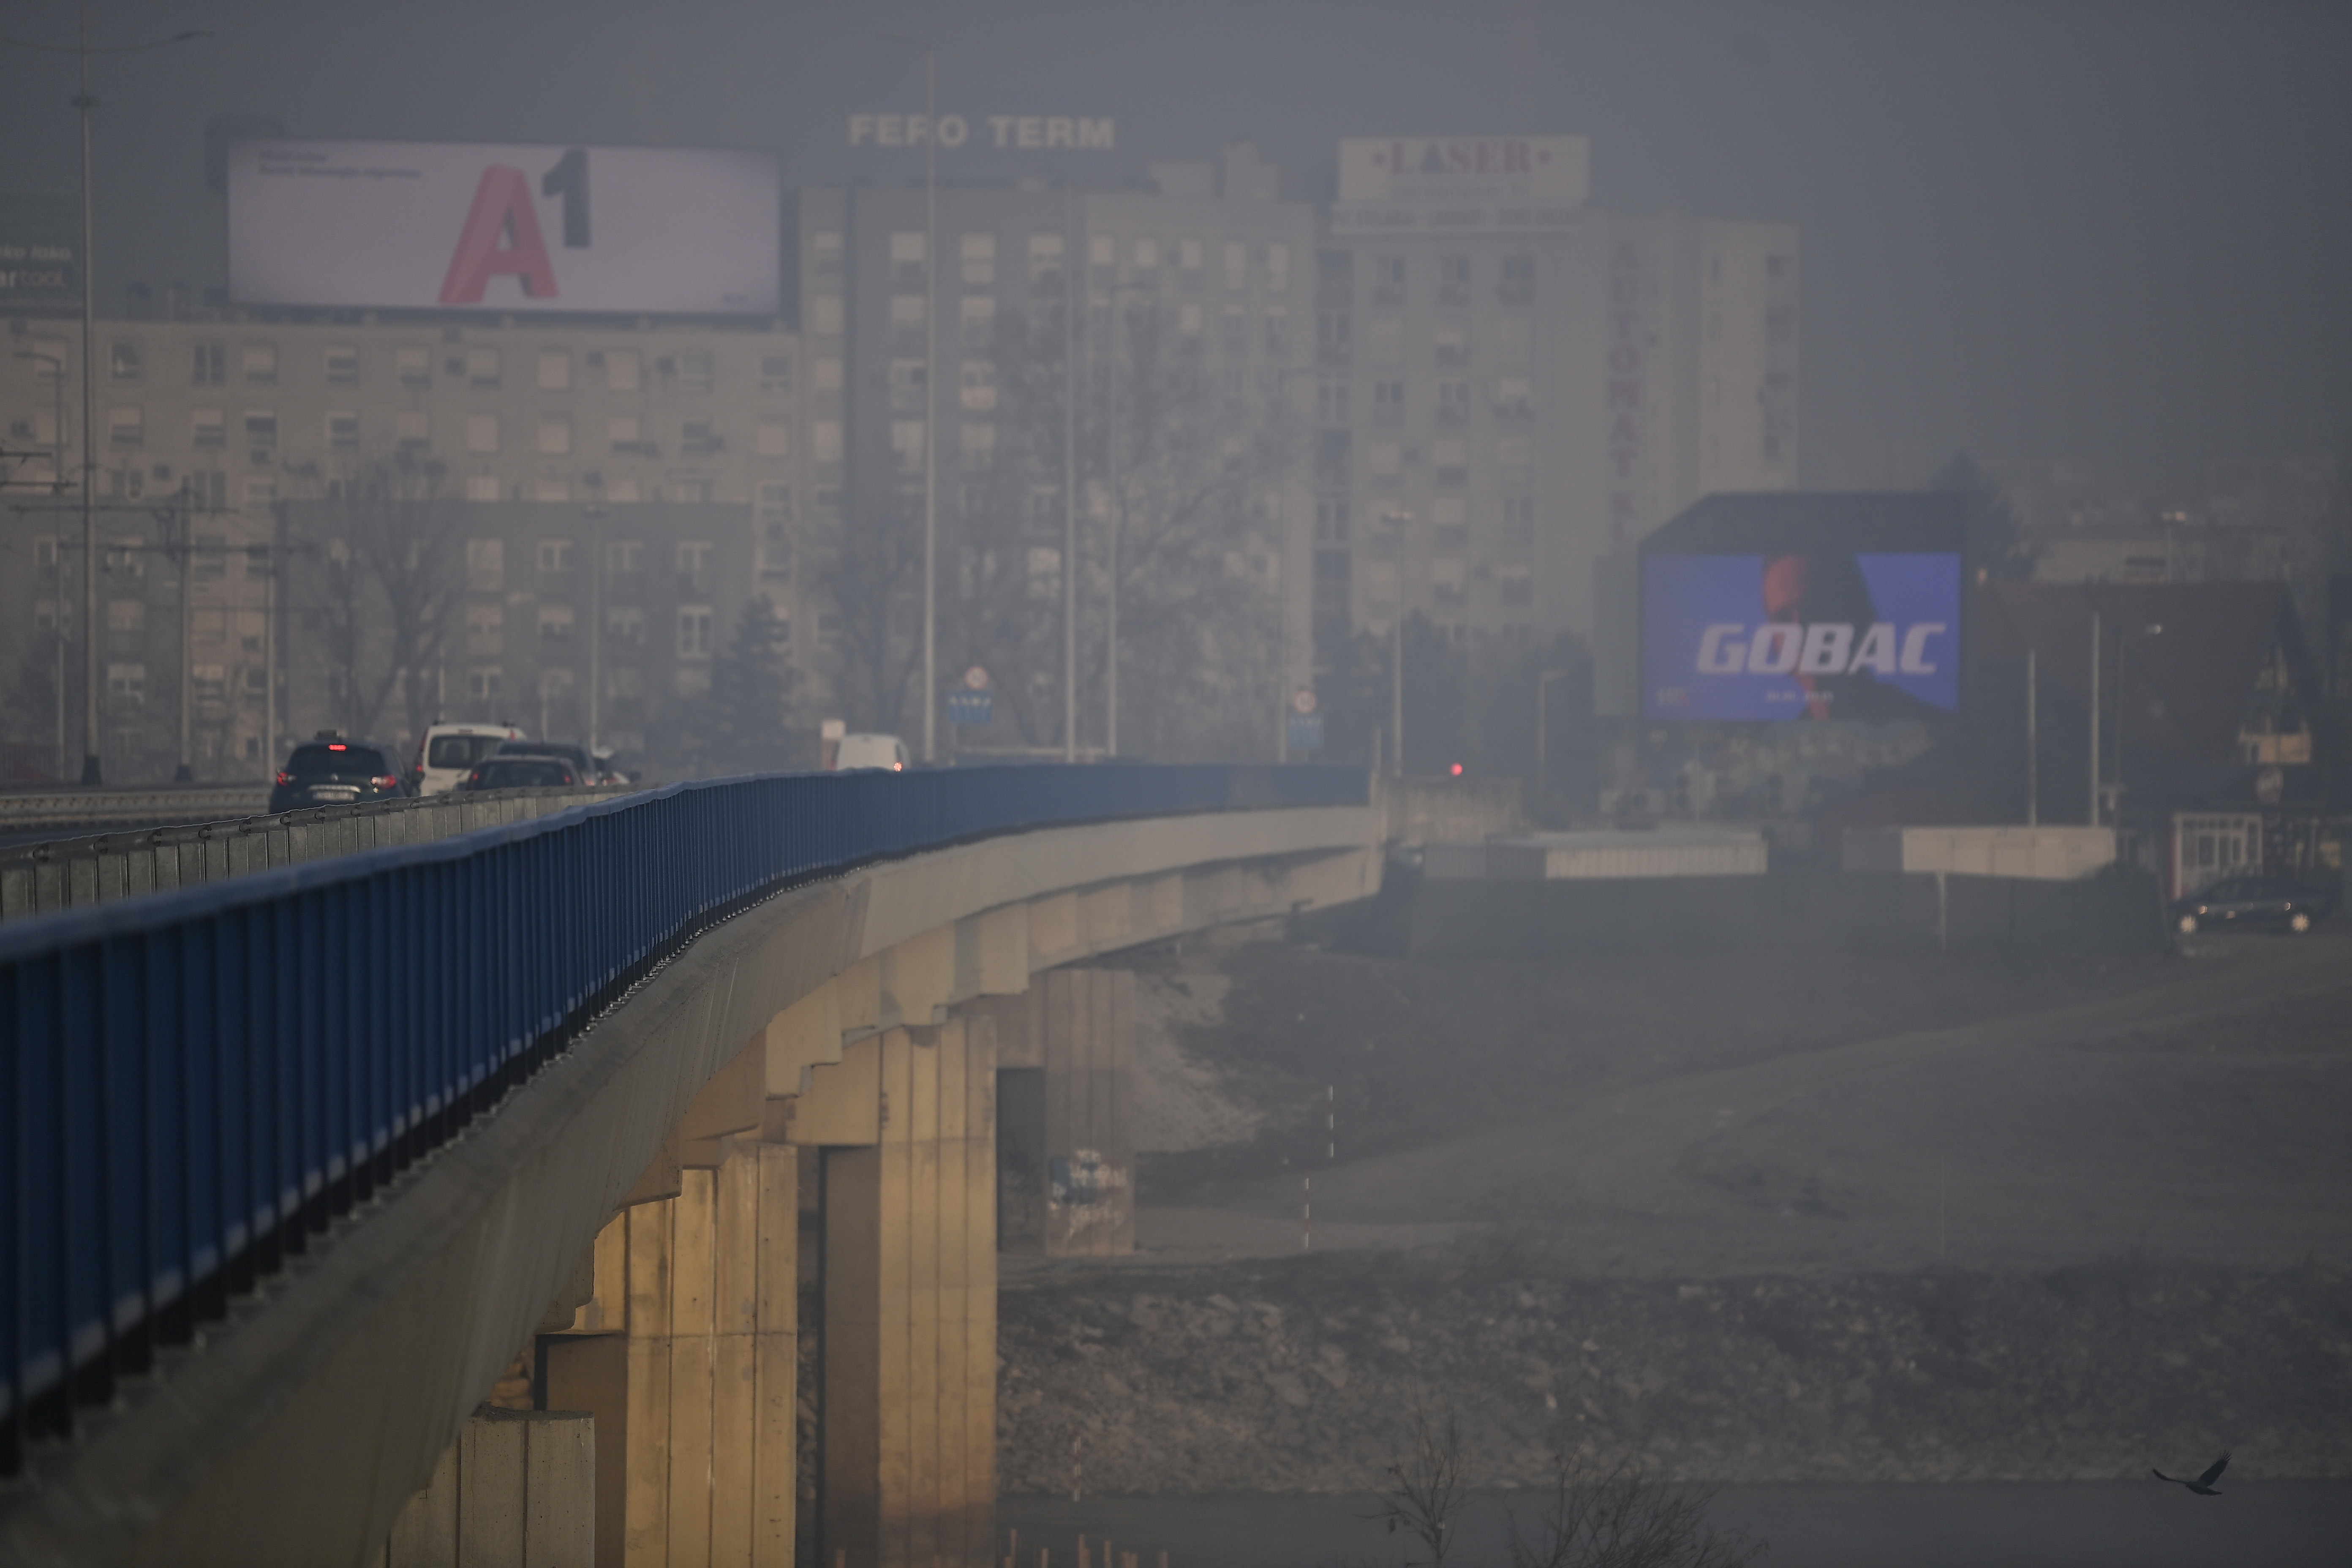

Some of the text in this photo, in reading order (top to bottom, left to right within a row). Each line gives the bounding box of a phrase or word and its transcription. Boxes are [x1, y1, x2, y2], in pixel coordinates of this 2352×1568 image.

[987, 114, 1116, 149] TERM
[1390, 140, 1532, 175] LASER
[438, 146, 591, 303] A1
[1608, 240, 1640, 478] AUTOMAT
[1696, 623, 1947, 674] GOBAC
